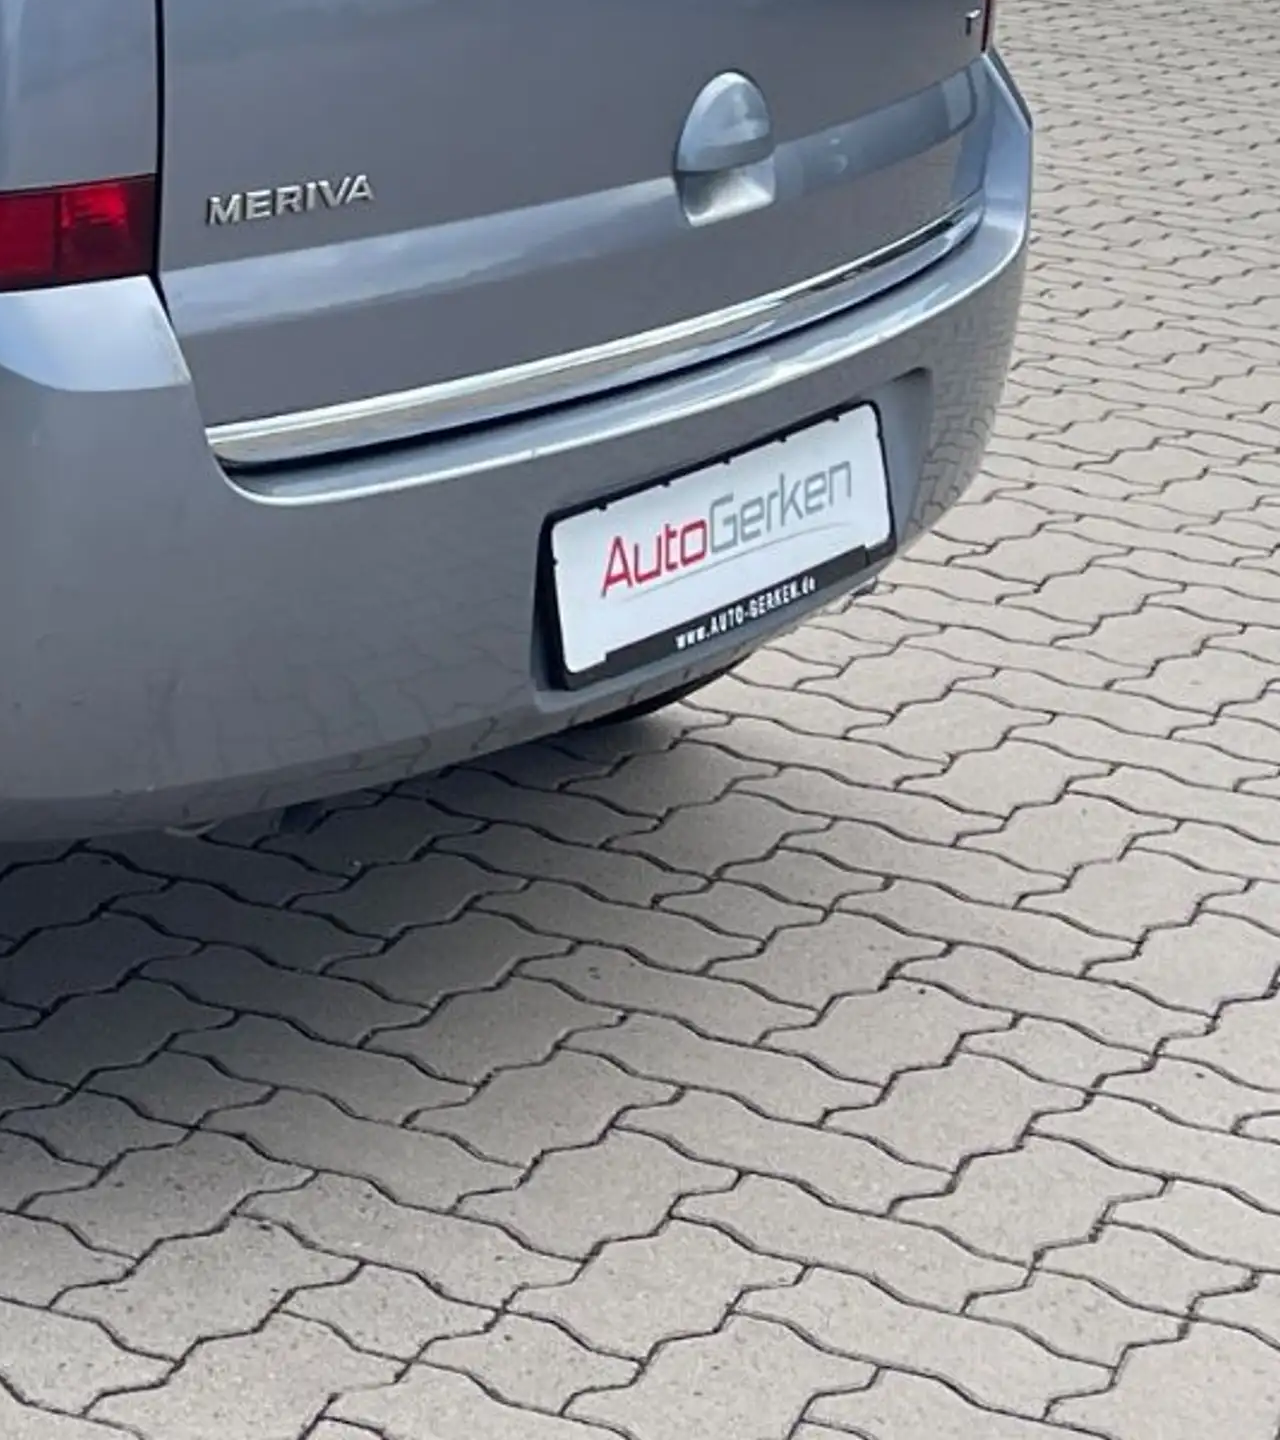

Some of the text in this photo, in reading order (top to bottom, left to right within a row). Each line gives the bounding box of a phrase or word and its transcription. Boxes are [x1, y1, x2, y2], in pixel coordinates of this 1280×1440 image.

[207, 174, 374, 226] MERIVA
[601, 460, 852, 597] AutoGerken
[675, 575, 816, 649] www.AUTO-GERKEN.de
